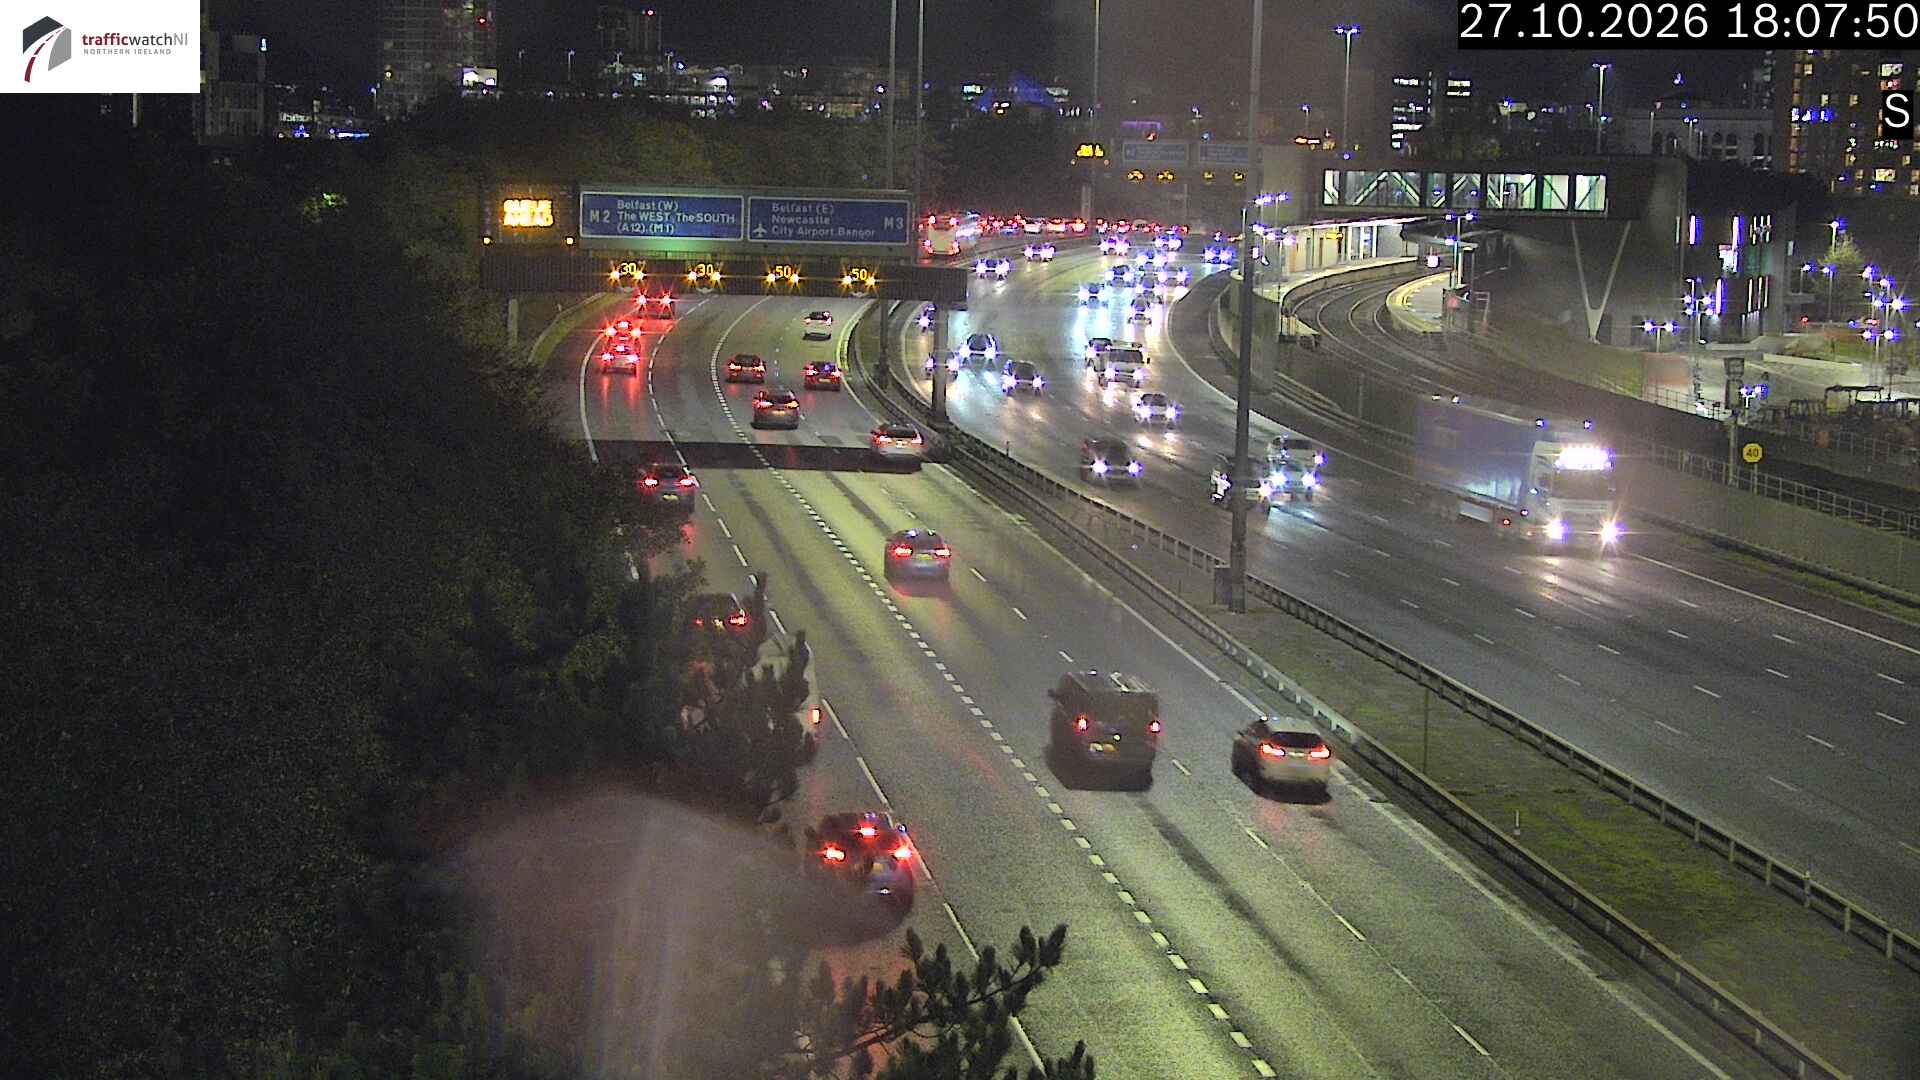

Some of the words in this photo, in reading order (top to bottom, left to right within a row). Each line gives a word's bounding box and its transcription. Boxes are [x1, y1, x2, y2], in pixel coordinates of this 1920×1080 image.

[617, 200, 656, 210] Belfast
[658, 200, 679, 211] (W)
[771, 203, 812, 213] Belfast
[815, 203, 834, 215] (E)
[589, 209, 611, 223] M2
[617, 211, 637, 221] The
[676, 213, 695, 223] The
[696, 213, 735, 224] SOUTH
[771, 215, 830, 224] Newcastle
[883, 216, 904, 230] M3
[771, 225, 793, 236] City
[837, 227, 875, 239] Bangor
[620, 262, 636, 275] 30
[698, 263, 713, 276] 30
[775, 265, 792, 278] 50
[851, 268, 868, 281] 50
[1746, 448, 1759, 457] 40
